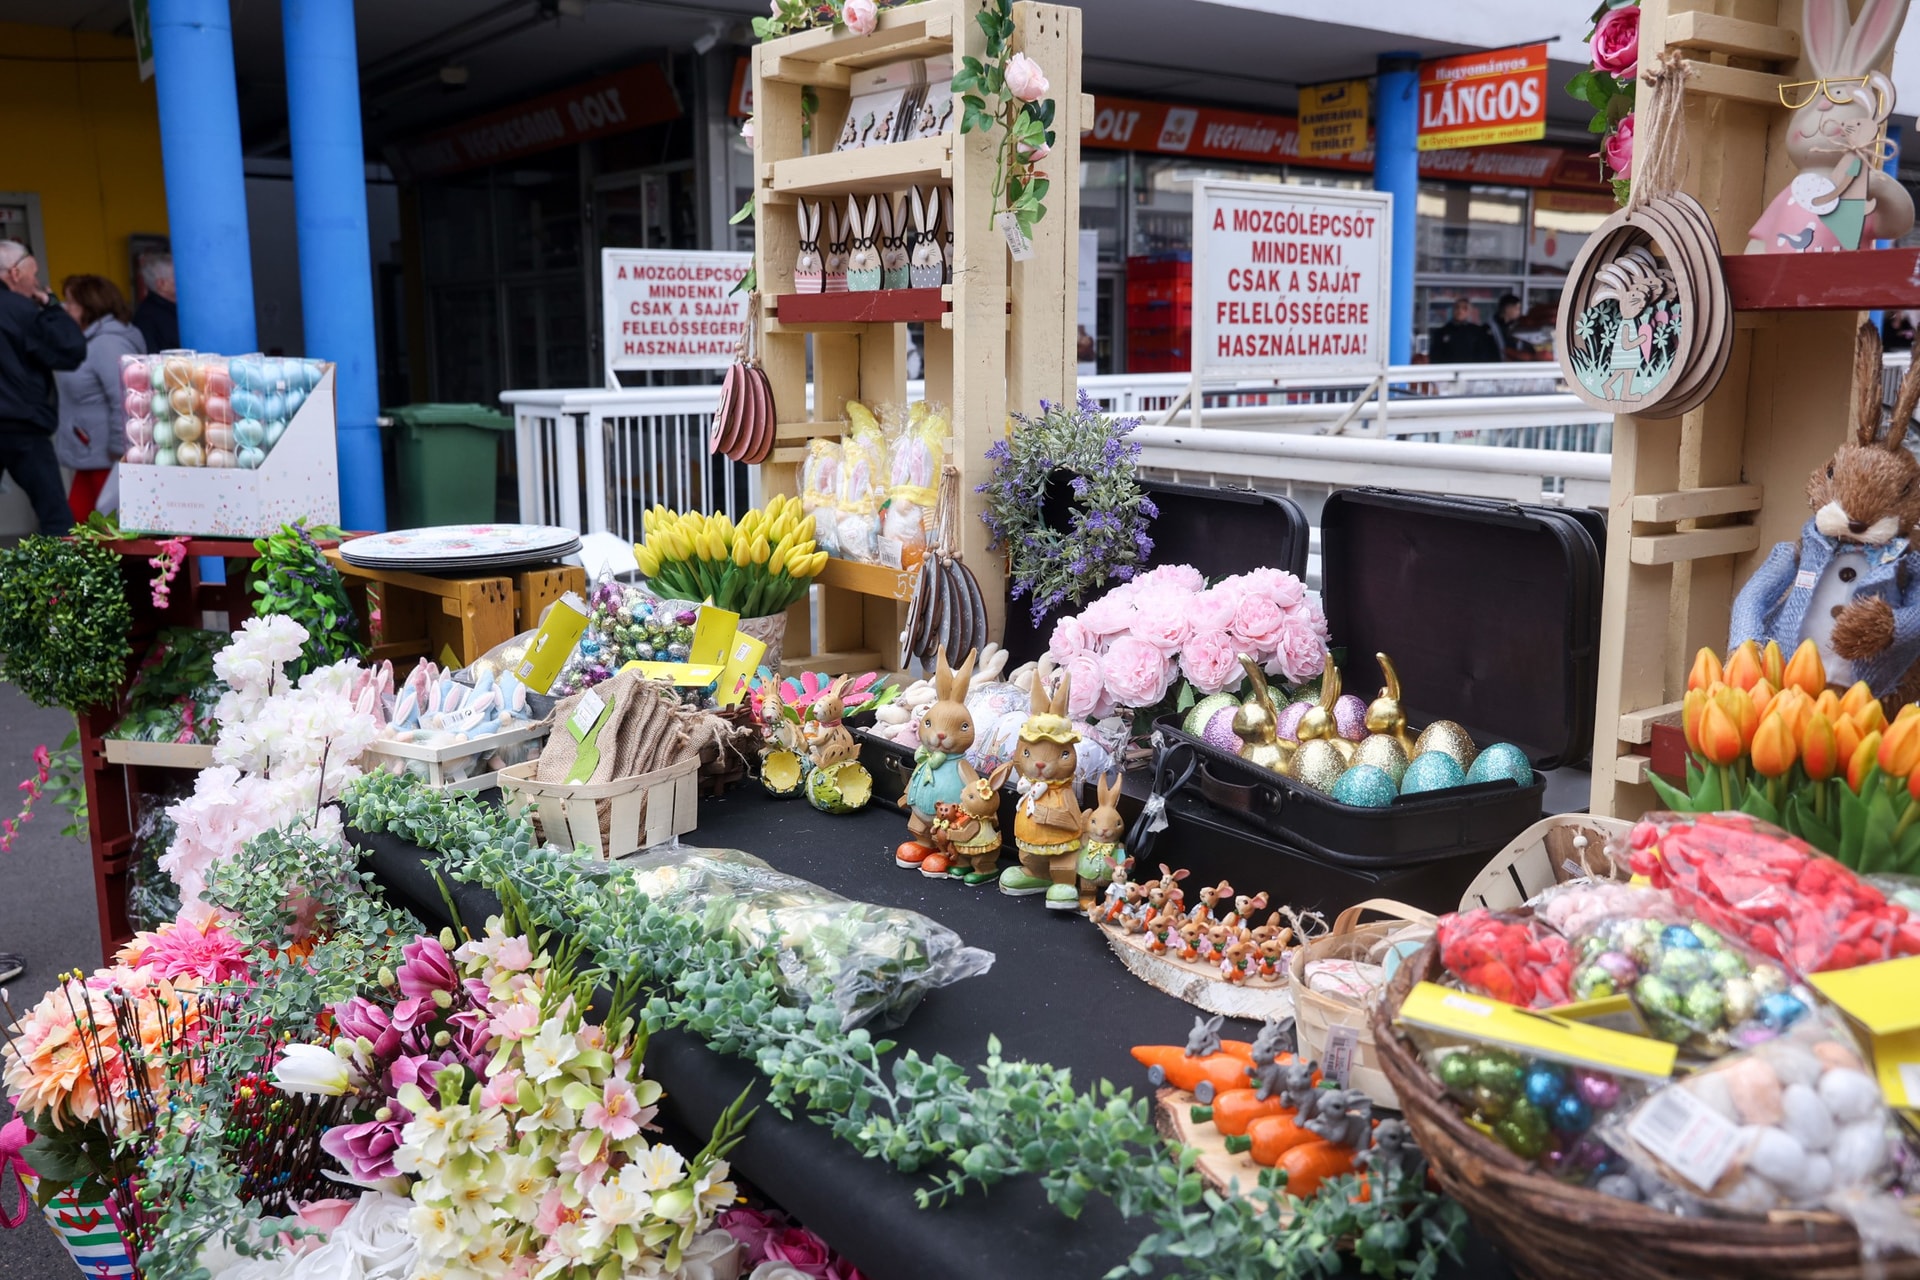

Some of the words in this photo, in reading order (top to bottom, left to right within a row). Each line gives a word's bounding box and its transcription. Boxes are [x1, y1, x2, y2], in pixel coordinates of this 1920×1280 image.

[1435, 58, 1528, 81] Hagyományos
[568, 87, 627, 133] BOLT
[1423, 78, 1540, 128] LÁNGOS
[1082, 108, 1140, 142] OLT
[1213, 208, 1225, 231] A
[1233, 205, 1375, 238] MOZGÓLÉPCSŐT
[1252, 241, 1341, 266] MINDENKI
[618, 266, 627, 280] A
[1228, 268, 1280, 291] CSAK
[1289, 271, 1300, 292] A
[1308, 265, 1360, 293] SAJÁT
[649, 285, 723, 299] MINDENKI
[630, 301, 672, 315] CSAK
[680, 302, 689, 315] A
[695, 299, 739, 316] SAJÁT
[1217, 295, 1369, 324] FELELŐSSÉGÉRE
[624, 338, 737, 355] HASZNÁLHATJ
[1218, 327, 1367, 357] HASZNÁLHATJA!
